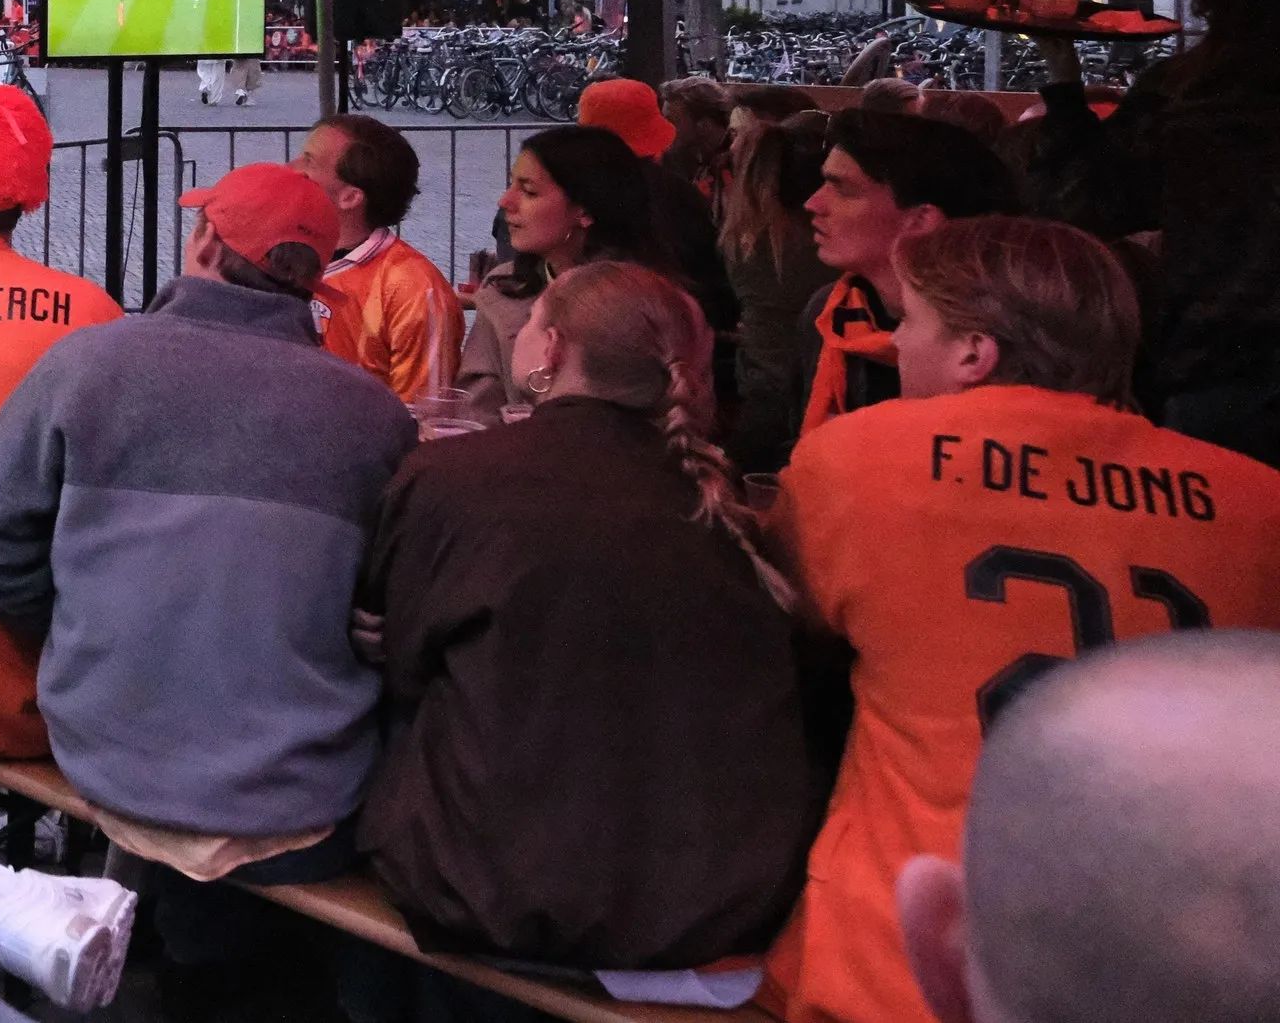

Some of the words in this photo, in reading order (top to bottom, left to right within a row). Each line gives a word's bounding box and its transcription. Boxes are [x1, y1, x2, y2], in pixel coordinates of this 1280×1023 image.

[931, 434, 964, 484] F.
[981, 438, 1049, 500] DE
[1066, 456, 1217, 521] JONG
